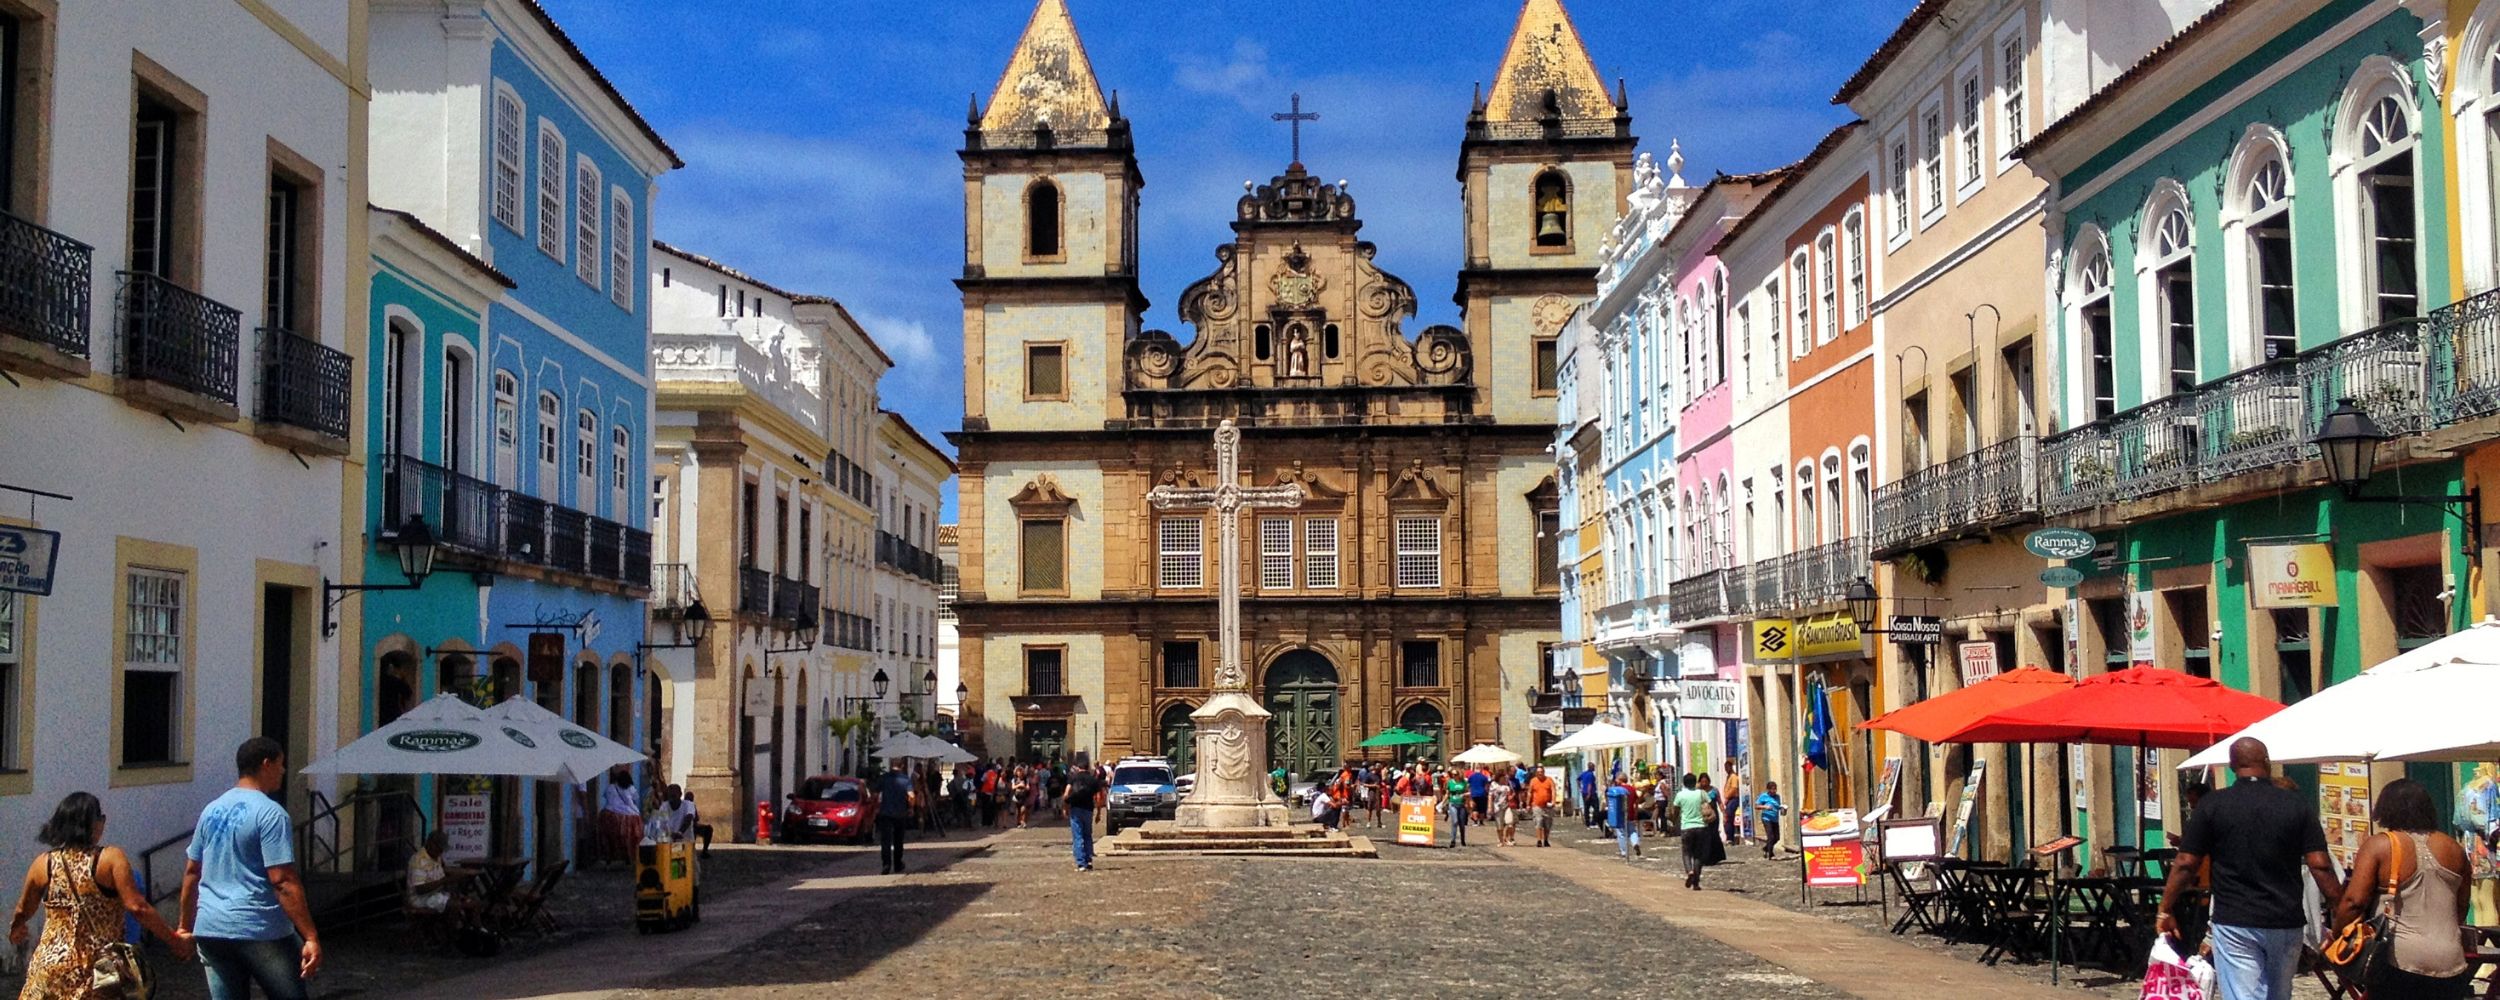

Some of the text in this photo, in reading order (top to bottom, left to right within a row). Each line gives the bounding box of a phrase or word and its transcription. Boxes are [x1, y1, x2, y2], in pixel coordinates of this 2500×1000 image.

[2034, 536, 2078, 548] Ramma
[1913, 616, 1940, 632] Nossa
[1686, 685, 1735, 700] ADVOCATUS
[399, 735, 462, 747] Ramma
[448, 798, 482, 807] Sale
[1407, 815, 1426, 823] CAR
